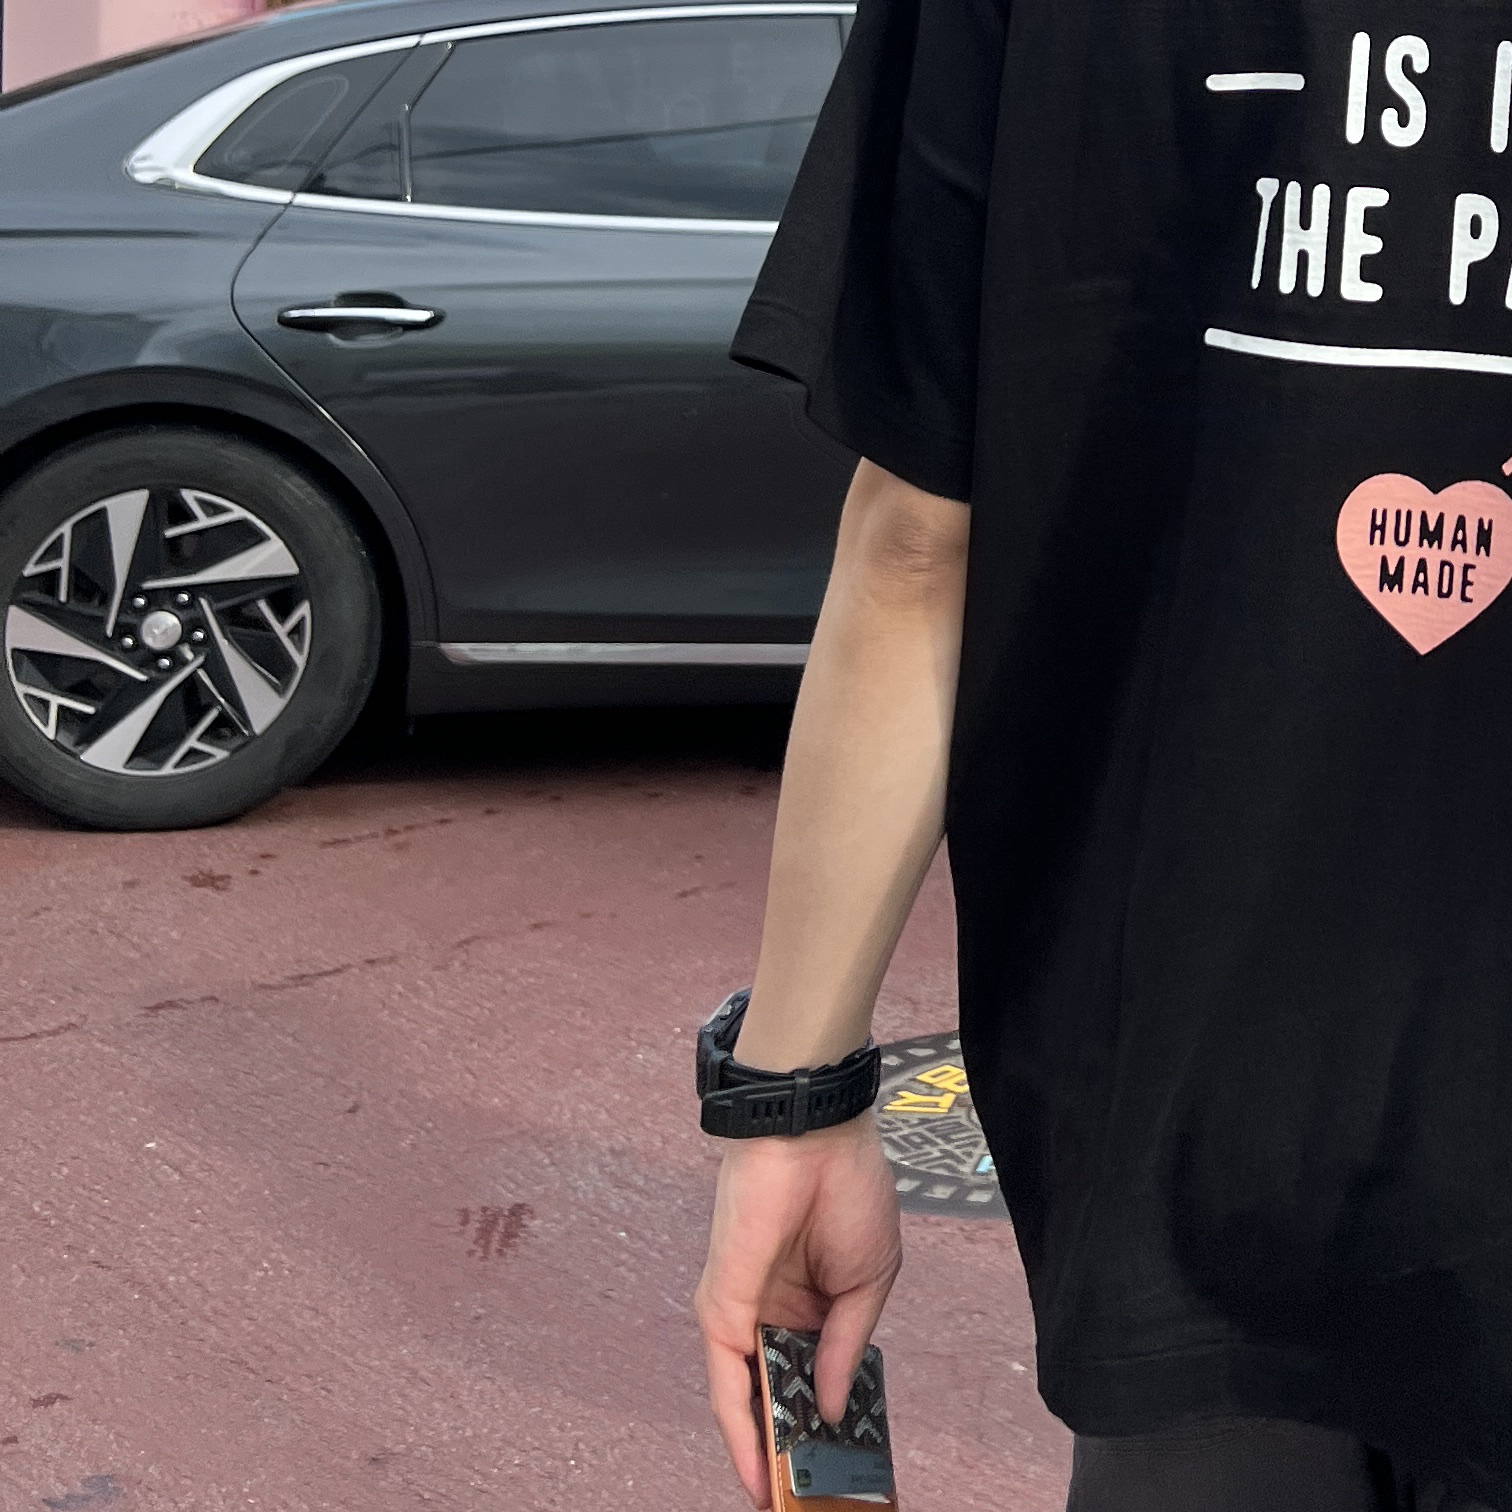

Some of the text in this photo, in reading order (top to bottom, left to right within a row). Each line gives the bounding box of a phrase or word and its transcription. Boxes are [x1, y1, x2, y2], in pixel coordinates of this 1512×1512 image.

[1346, 31, 1430, 148] IS
[1251, 177, 1390, 303] THE
[1369, 508, 1494, 558] HUMAN
[1378, 554, 1477, 604] MADE
